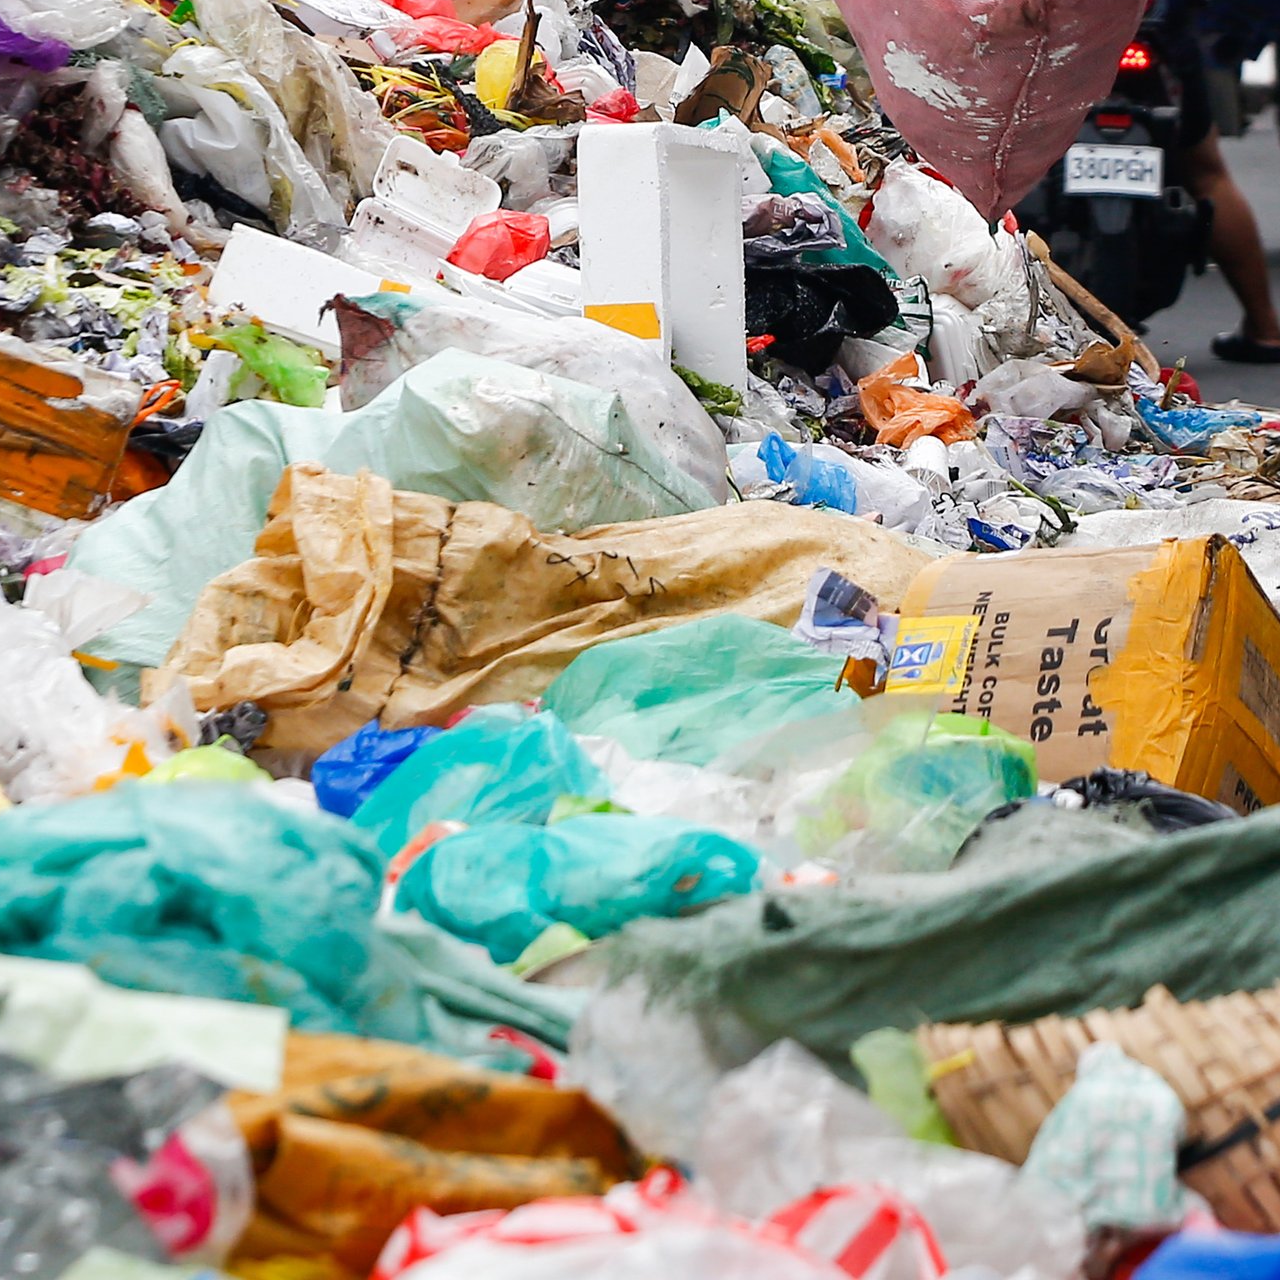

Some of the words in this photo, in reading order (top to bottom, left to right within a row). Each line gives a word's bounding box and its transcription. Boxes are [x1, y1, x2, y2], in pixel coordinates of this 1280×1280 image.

[984, 612, 1011, 669] BULK
[975, 676, 998, 718] COF
[1029, 617, 1080, 743] Taste
